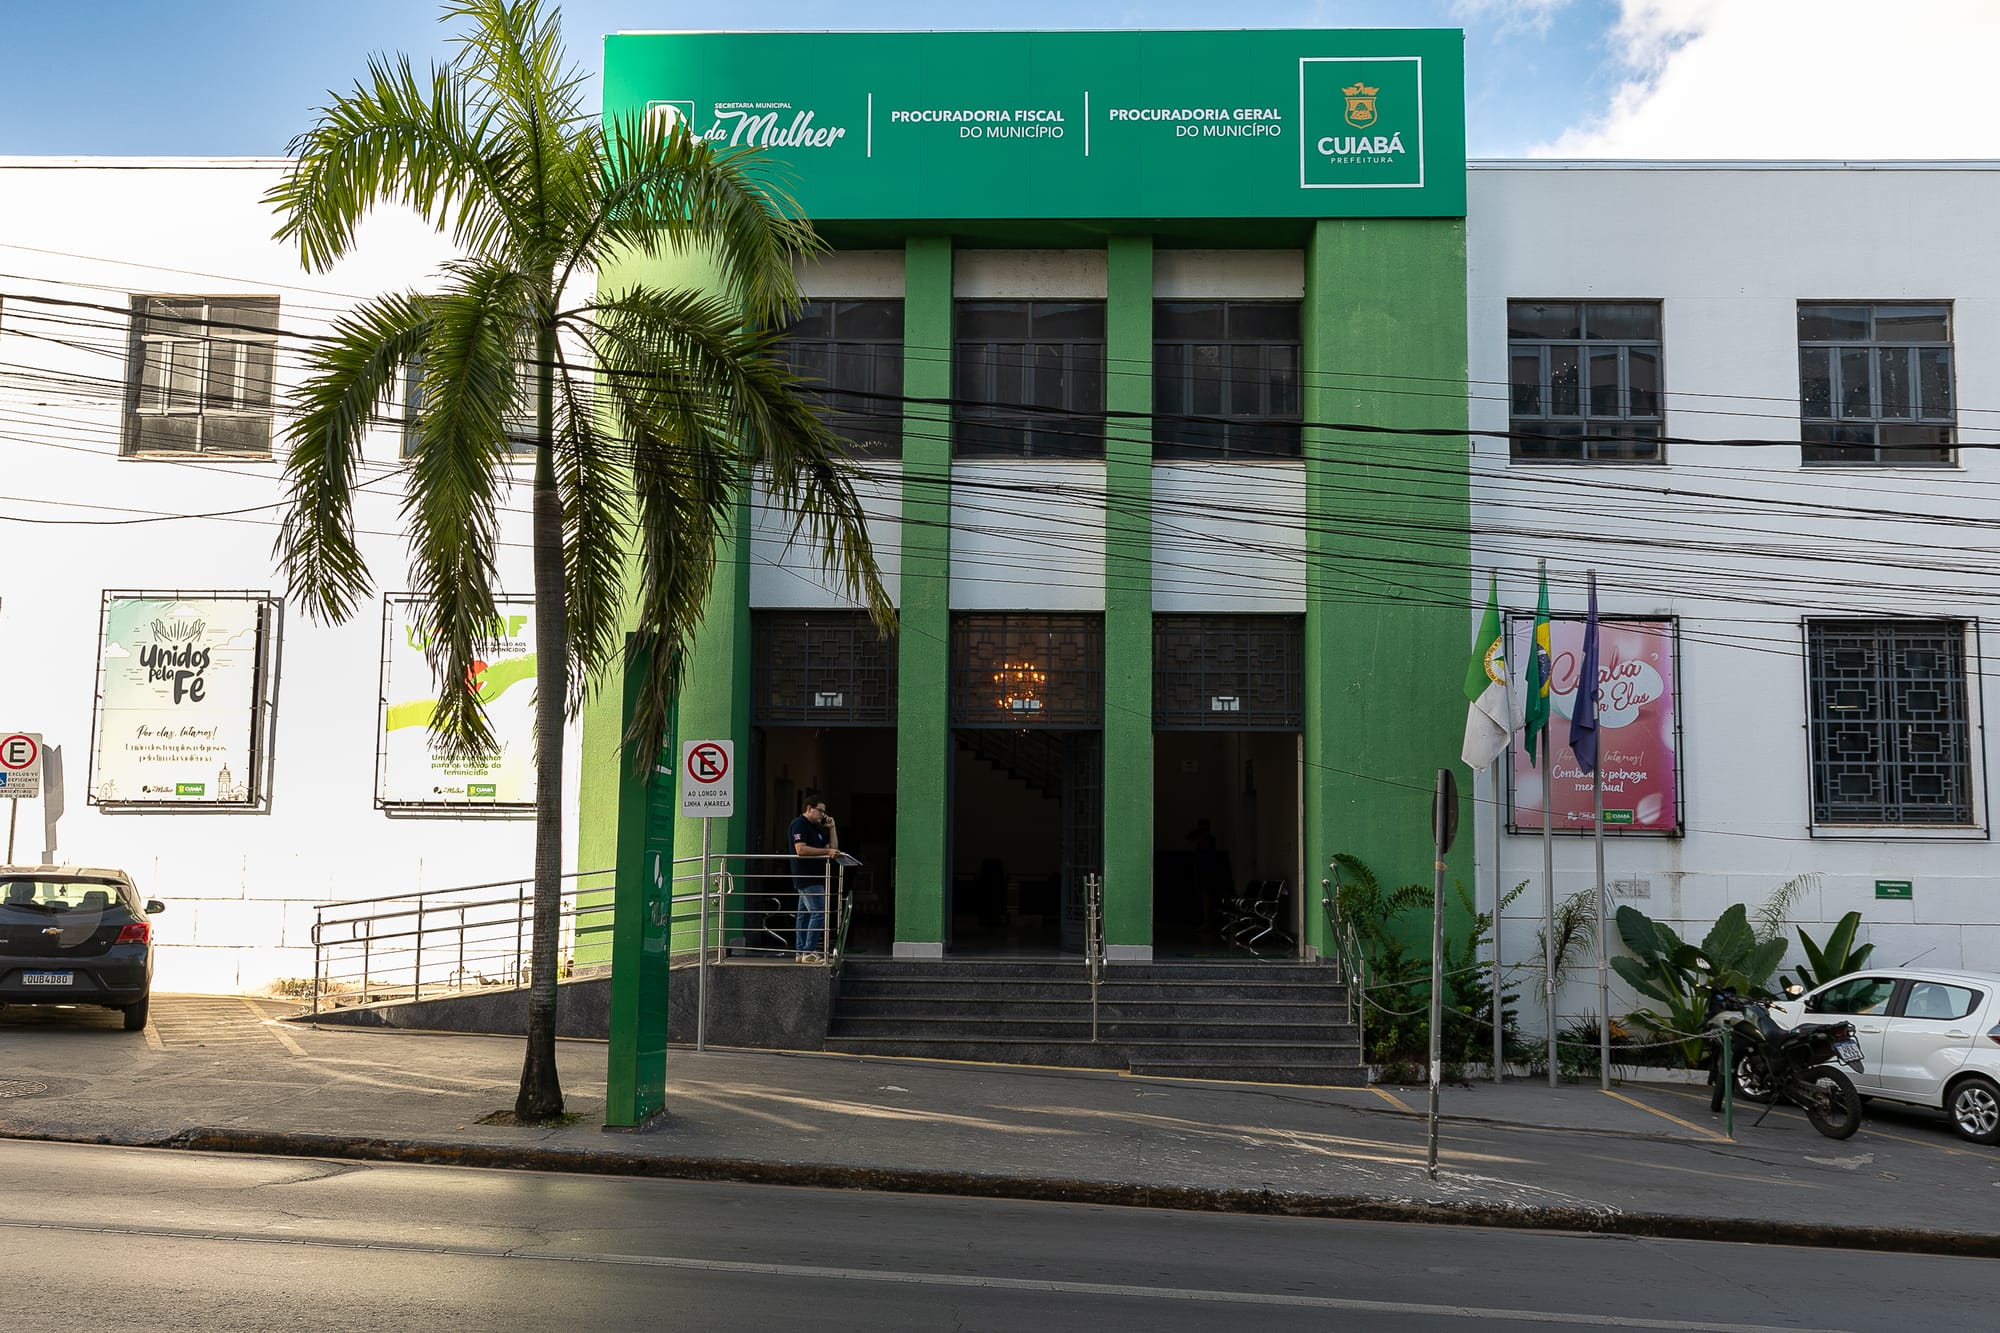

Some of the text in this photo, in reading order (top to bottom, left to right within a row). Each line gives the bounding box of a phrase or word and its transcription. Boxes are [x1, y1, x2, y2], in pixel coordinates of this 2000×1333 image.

[891, 110, 1065, 122] PROCURADORIA FISCAL
[1109, 108, 1282, 121] PROCURADORIA GERAL
[703, 110, 846, 150] da Mulher
[959, 124, 1064, 138] DO MUNICÍPIO
[1176, 122, 1281, 137] DO MUNICÍPIO
[1317, 131, 1406, 155] CUIABÁ
[139, 642, 211, 669] Unidos
[149, 665, 174, 683] pela
[174, 668, 206, 705] Fé
[9, 742, 26, 763] E
[700, 751, 717, 775] E
[1608, 768, 1648, 784] pobreza
